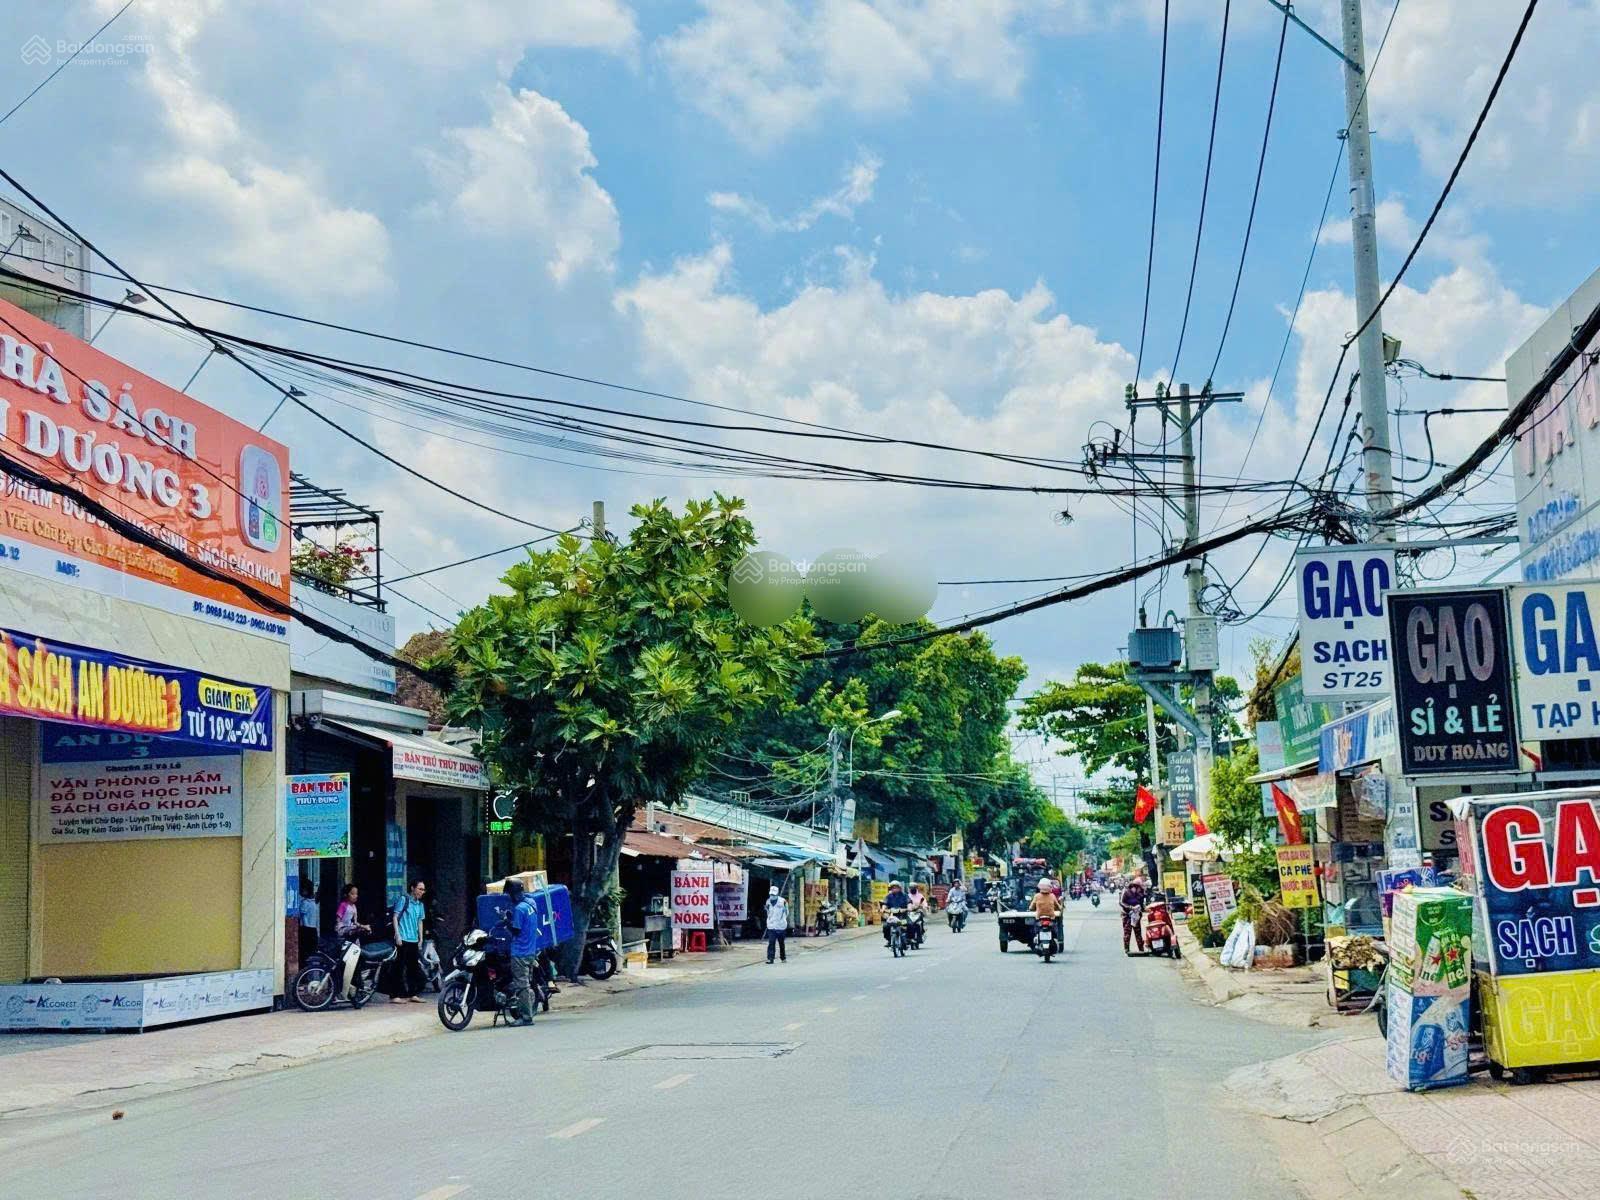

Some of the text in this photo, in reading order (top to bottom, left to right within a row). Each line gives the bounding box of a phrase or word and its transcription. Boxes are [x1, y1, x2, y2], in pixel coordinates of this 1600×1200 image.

[82, 379, 197, 460] SÁCH
[22, 409, 182, 508] DƯƠNG
[189, 483, 212, 519] 3
[1303, 558, 1390, 629] GẠO
[1313, 639, 1388, 668] SẠCH
[1406, 602, 1495, 698] GẠO
[17, 638, 72, 714] SÁCH
[77, 659, 104, 721] AN
[108, 664, 168, 729] DƯƠNG
[1323, 671, 1383, 689] ST25
[205, 684, 253, 712] GIẢM GIÁ
[1411, 697, 1436, 736] SỈ
[1444, 705, 1464, 734] &
[1471, 693, 1504, 733] LẺ
[1531, 702, 1581, 734] TẠP
[187, 707, 267, 747] TỪ 10%-20%
[55, 735, 101, 747] AN
[131, 746, 149, 757] 3
[1413, 740, 1509, 762] DUY HOÀNG
[404, 751, 421, 765] BÁN
[422, 755, 437, 768] TRÚ
[459, 762, 479, 775] DUNG
[50, 770, 221, 788] VĂN PHÒNG PHẨM
[83, 789, 134, 800] DÙNG
[141, 788, 179, 800] HỌC
[186, 785, 231, 796] SINH
[50, 799, 209, 814] SÁCH GIÁO KHOA
[674, 874, 709, 888] BÁNH
[674, 890, 709, 906] CUỐN
[674, 910, 710, 924] NÓNG
